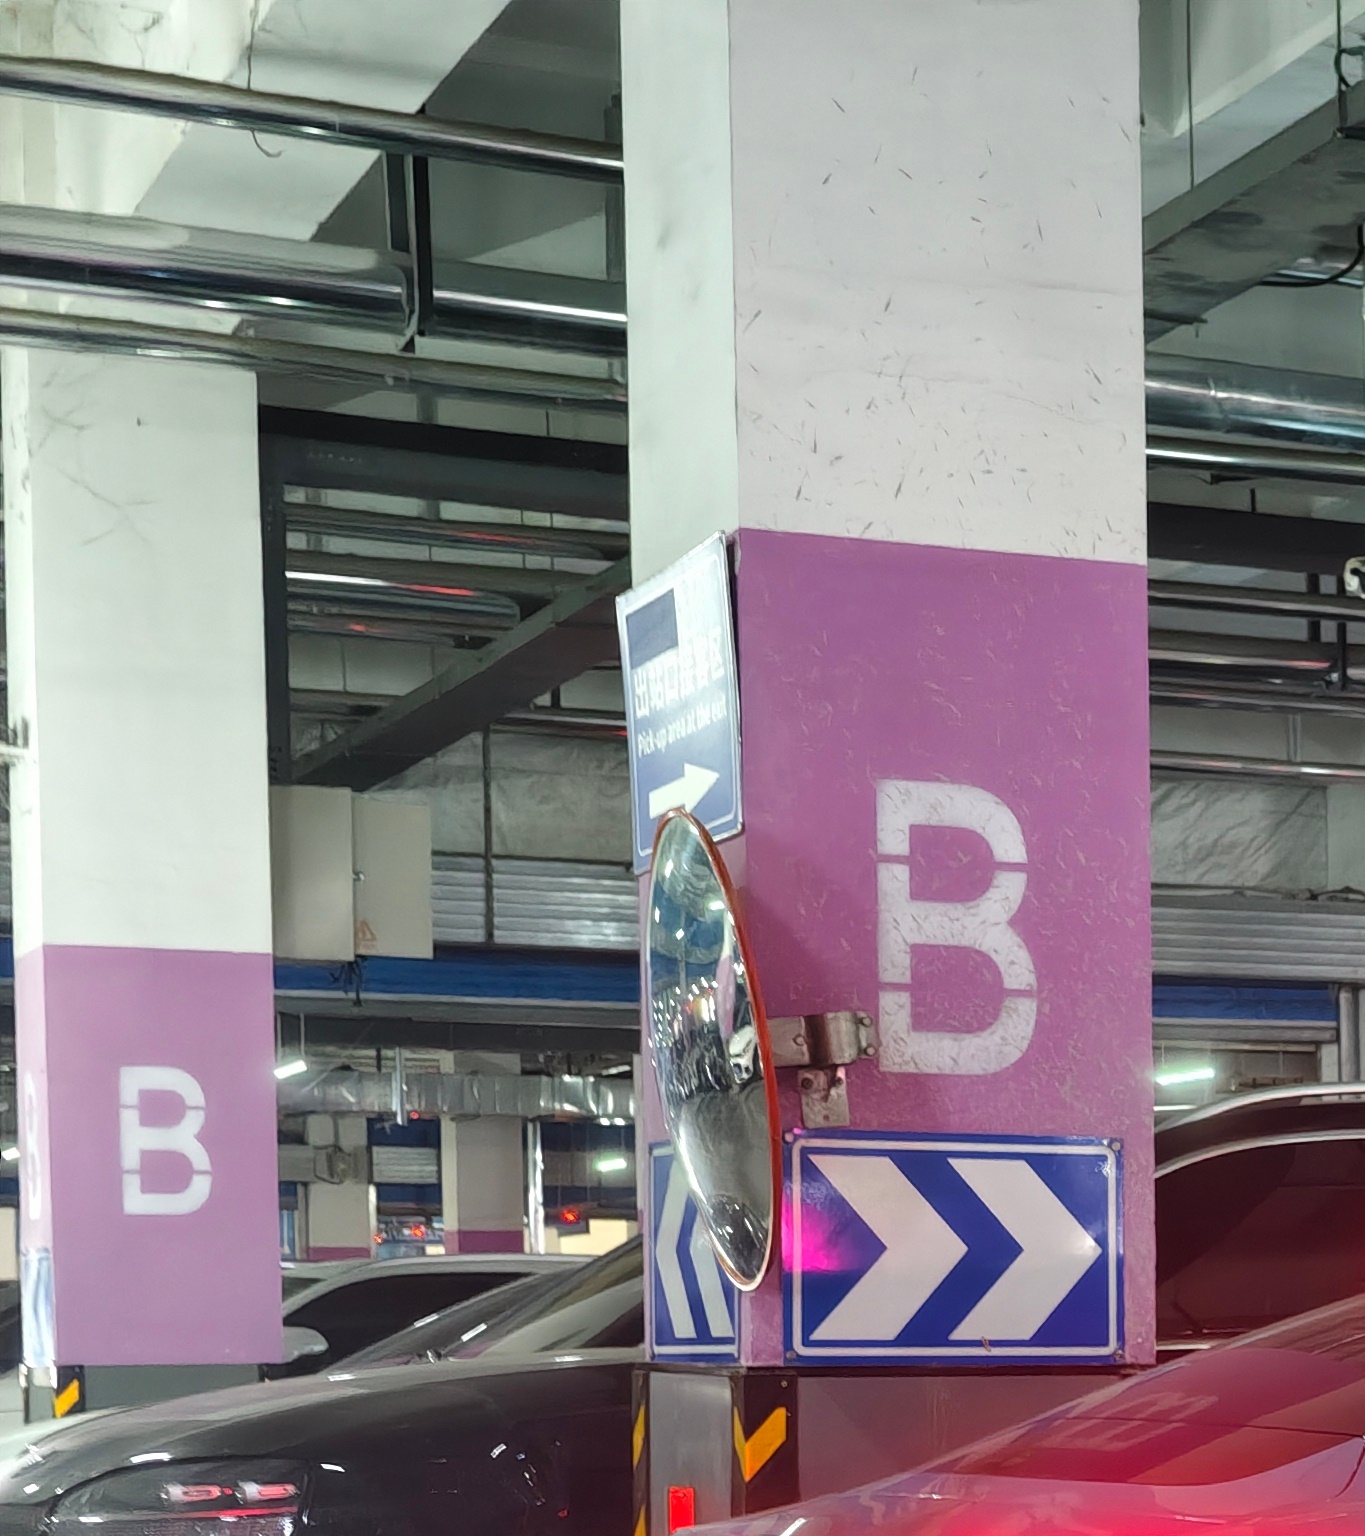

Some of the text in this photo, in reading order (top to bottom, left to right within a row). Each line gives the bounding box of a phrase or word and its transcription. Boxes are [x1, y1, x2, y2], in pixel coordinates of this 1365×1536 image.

[637, 727, 667, 758] Pick-up
[668, 716, 686, 744] area
[686, 710, 696, 735] at
[697, 701, 711, 729] the
[877, 779, 1037, 1075] B
[119, 1066, 212, 1216] B
